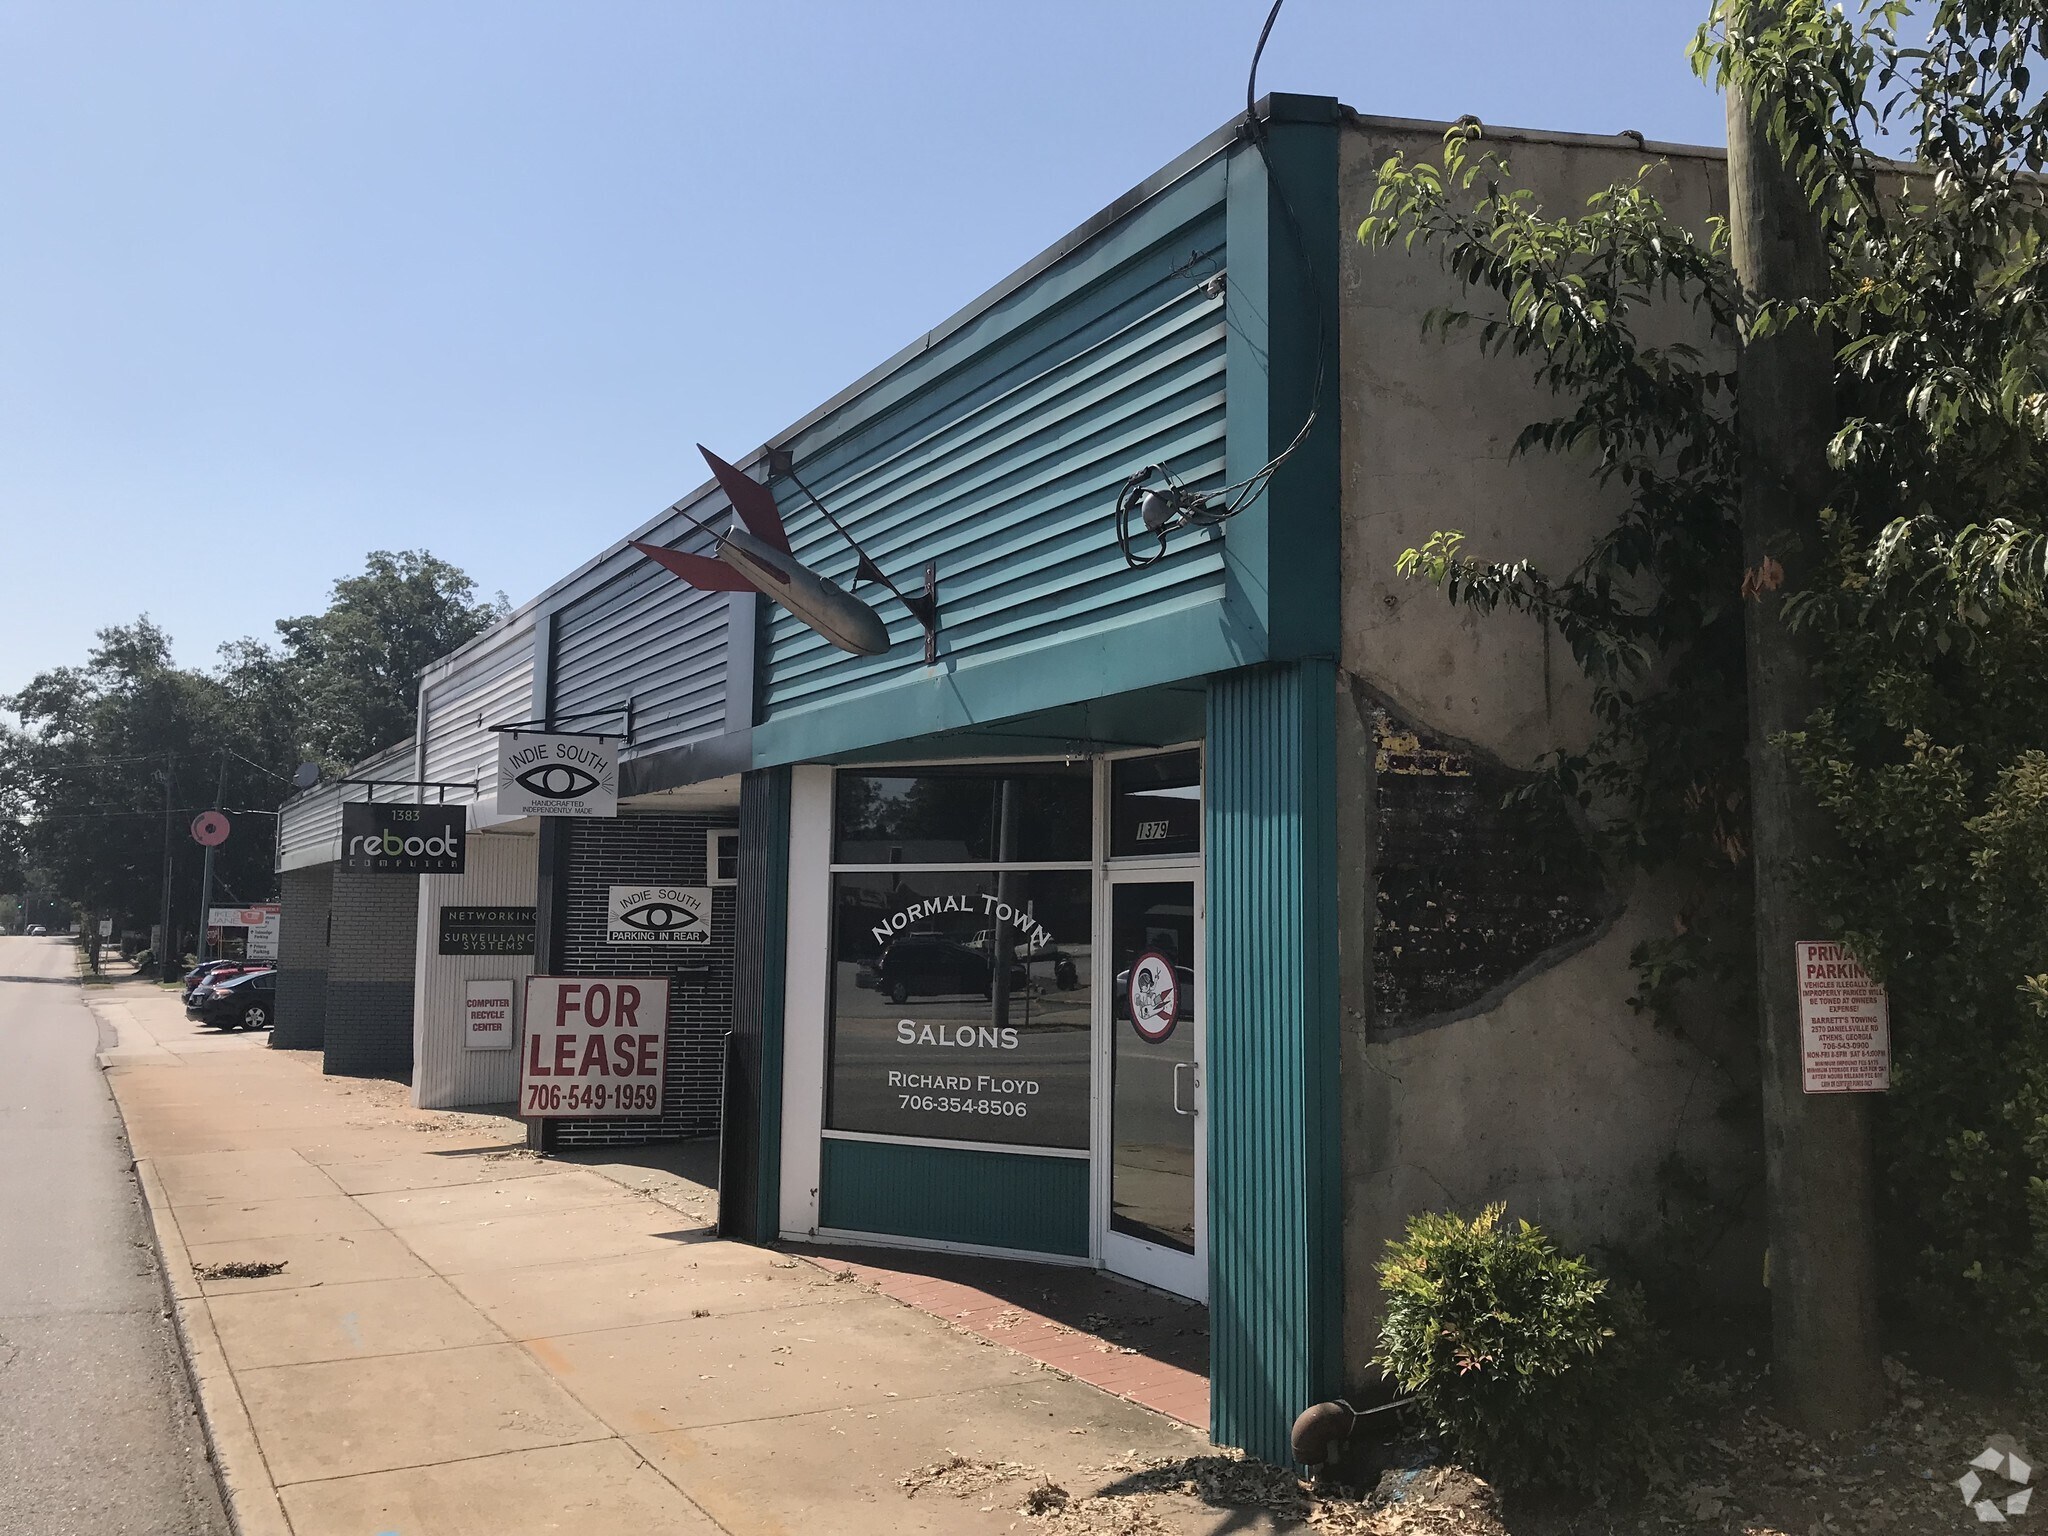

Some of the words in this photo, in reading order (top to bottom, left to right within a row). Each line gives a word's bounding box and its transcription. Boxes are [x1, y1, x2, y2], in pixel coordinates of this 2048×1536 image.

[508, 744, 548, 770] INDIE
[556, 743, 608, 774] SOUTH
[522, 806, 572, 814] INDEPENDENTLY
[531, 800, 584, 808] HANDCRAFTED
[391, 810, 420, 821] 1383
[1138, 822, 1168, 839] 1379
[349, 824, 458, 857] reboot
[349, 859, 458, 868] COMPUTER
[620, 890, 652, 909] INDIE
[658, 888, 702, 910] SOUTH
[871, 894, 974, 946] NORMAL
[980, 893, 1052, 948] TOWN
[444, 933, 535, 942] SURVEILLANC
[612, 932, 655, 941] PARKING
[659, 932, 669, 940] IN
[673, 932, 700, 941] REAR
[463, 942, 524, 951] SYSTEMS
[466, 999, 510, 1008] COMPUTER
[556, 984, 641, 1028] FOR
[470, 1010, 504, 1020] RECYCLE
[472, 1022, 502, 1032] CENTER
[896, 1019, 1020, 1050] SALONS
[529, 1033, 659, 1078] LEASE
[888, 1070, 972, 1092] RICHARD
[977, 1075, 1040, 1095] FLOYD
[528, 1084, 657, 1110] 706-549-1959
[898, 1094, 1027, 1117] 706-354-8506
